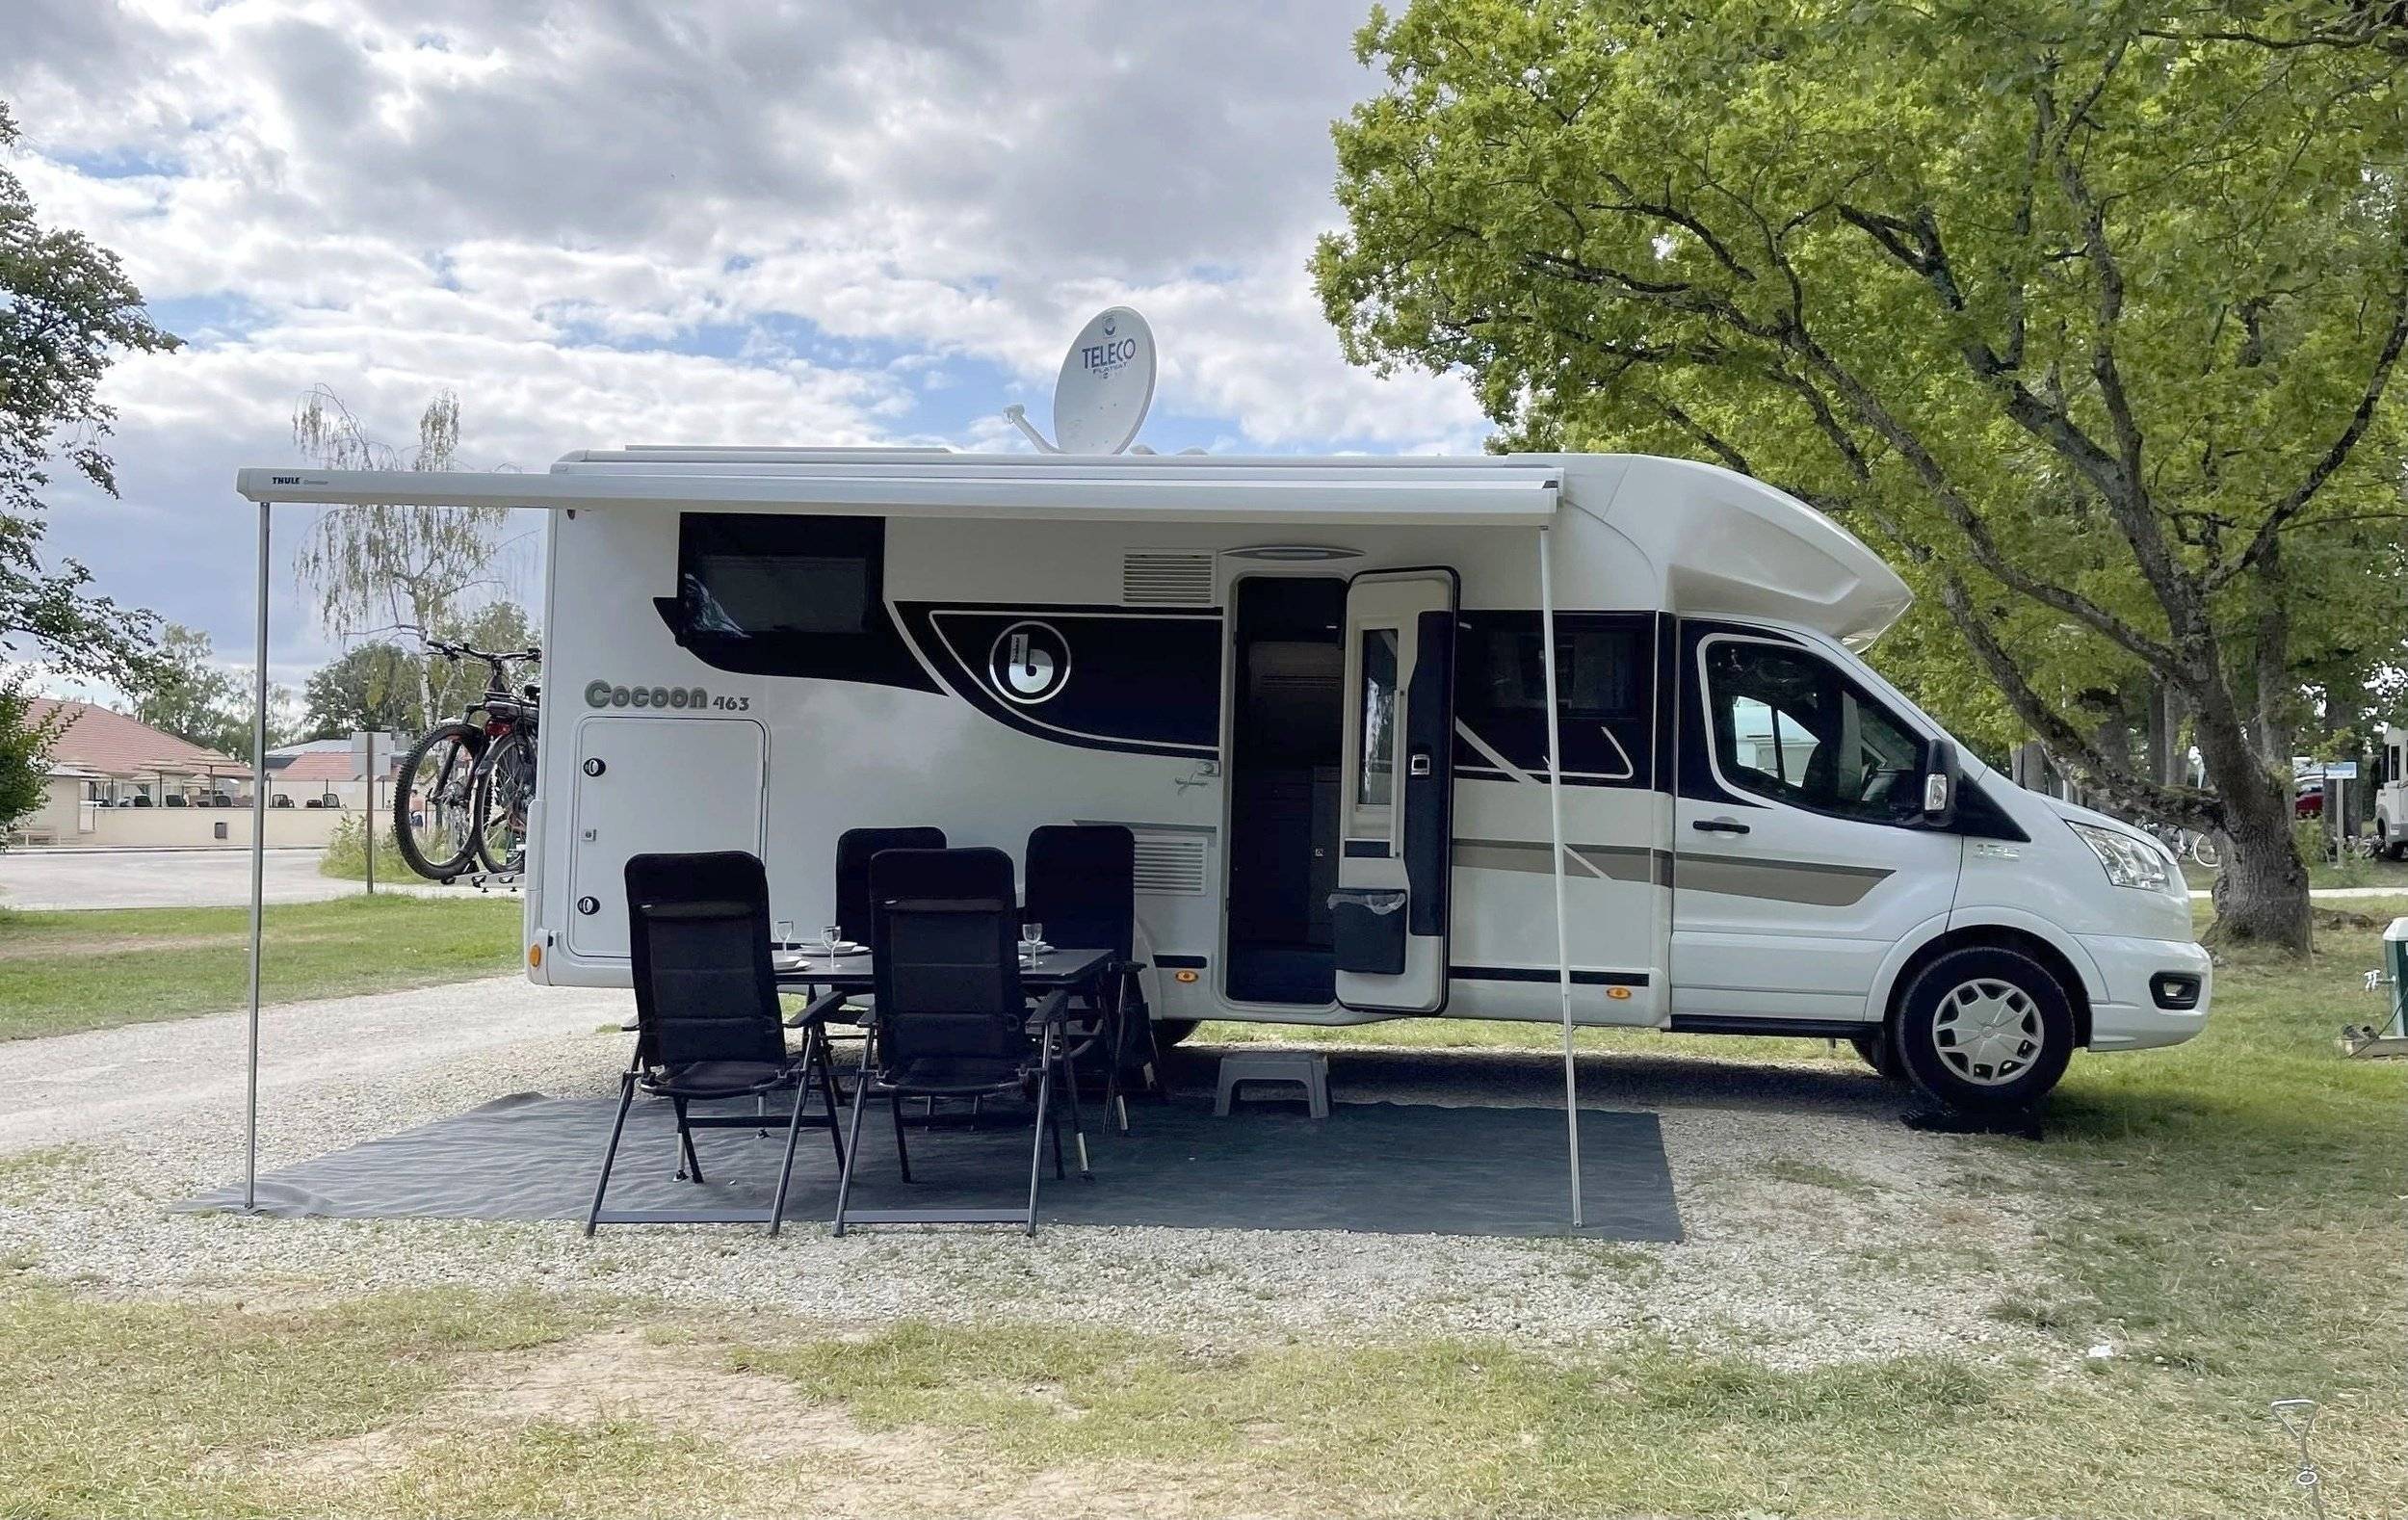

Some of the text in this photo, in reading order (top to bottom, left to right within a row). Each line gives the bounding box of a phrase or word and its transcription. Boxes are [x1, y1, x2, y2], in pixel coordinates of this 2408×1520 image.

[1082, 338, 1136, 369] TELECO
[584, 679, 750, 711] Cocoon 463
